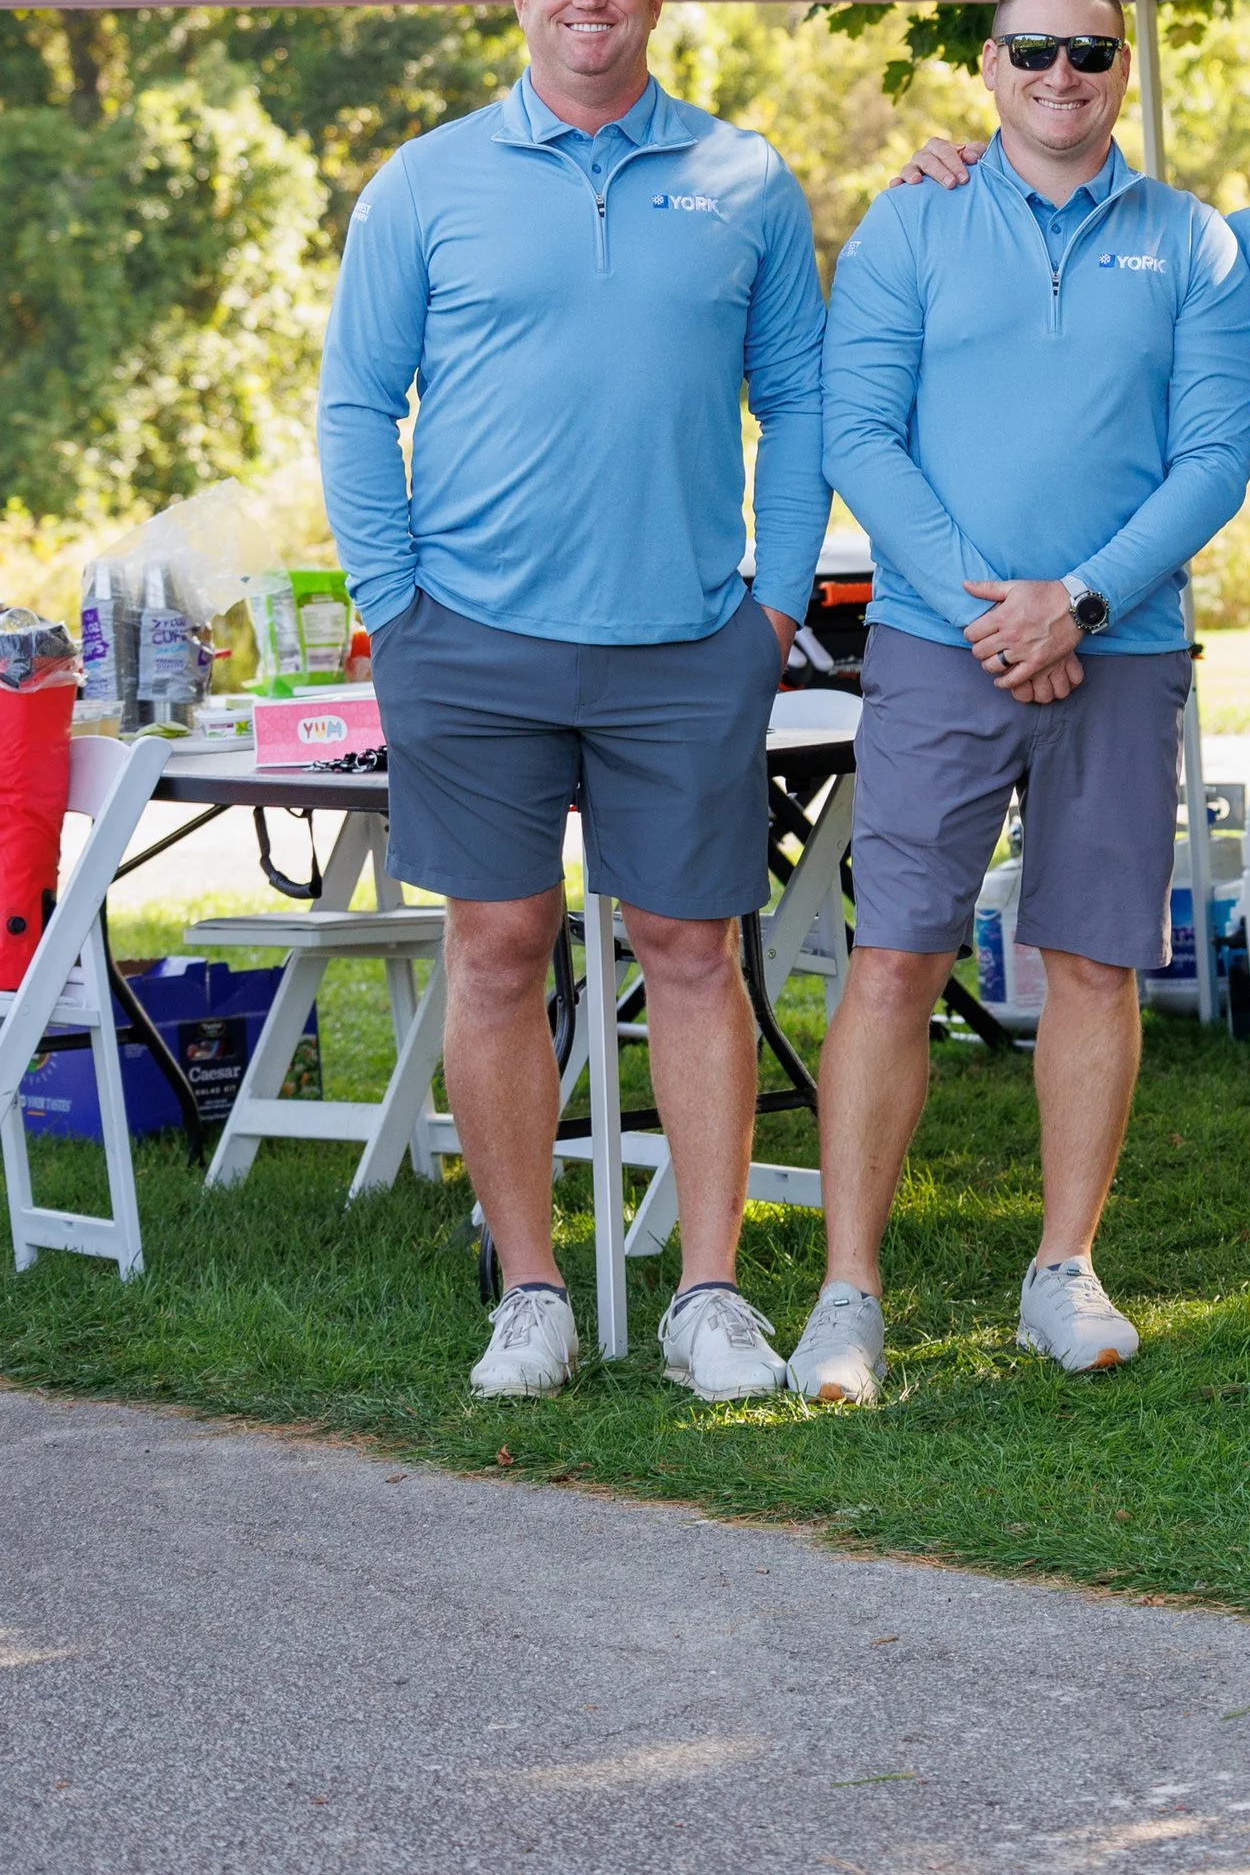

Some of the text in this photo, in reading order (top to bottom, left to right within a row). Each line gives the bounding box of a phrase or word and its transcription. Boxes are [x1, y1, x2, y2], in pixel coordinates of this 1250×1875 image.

[669, 195, 719, 212] YORK
[1116, 255, 1166, 273] YORK
[303, 721, 342, 738] YUM
[188, 1066, 241, 1082] Caesar
